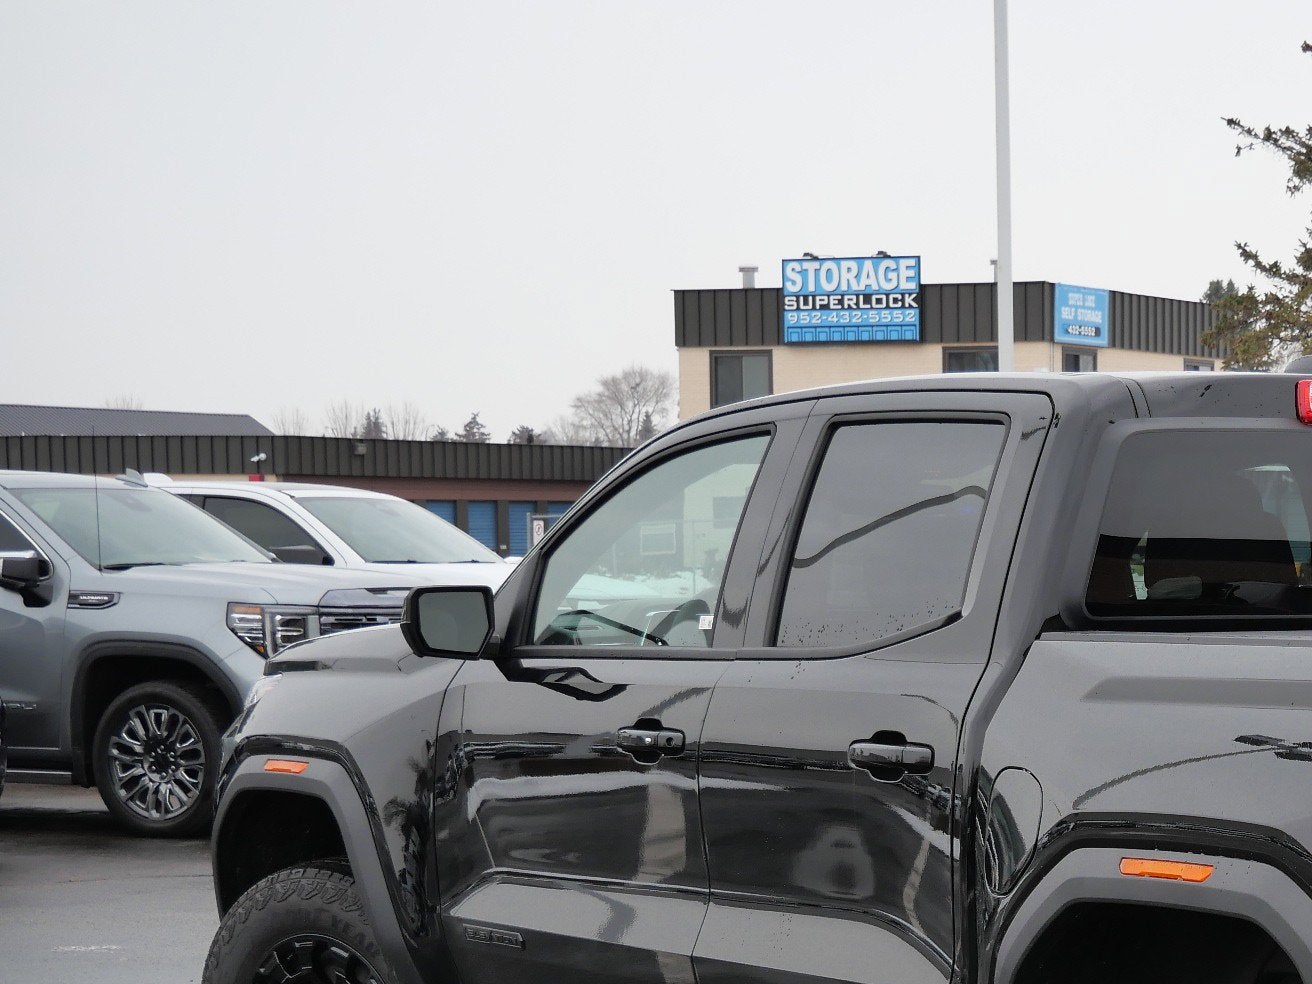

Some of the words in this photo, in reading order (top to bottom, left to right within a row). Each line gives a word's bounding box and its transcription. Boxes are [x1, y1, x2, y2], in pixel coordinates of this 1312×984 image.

[785, 259, 916, 293] STORAGE
[784, 294, 919, 310] SUPERLOCK
[788, 311, 915, 324] 952-432-5552
